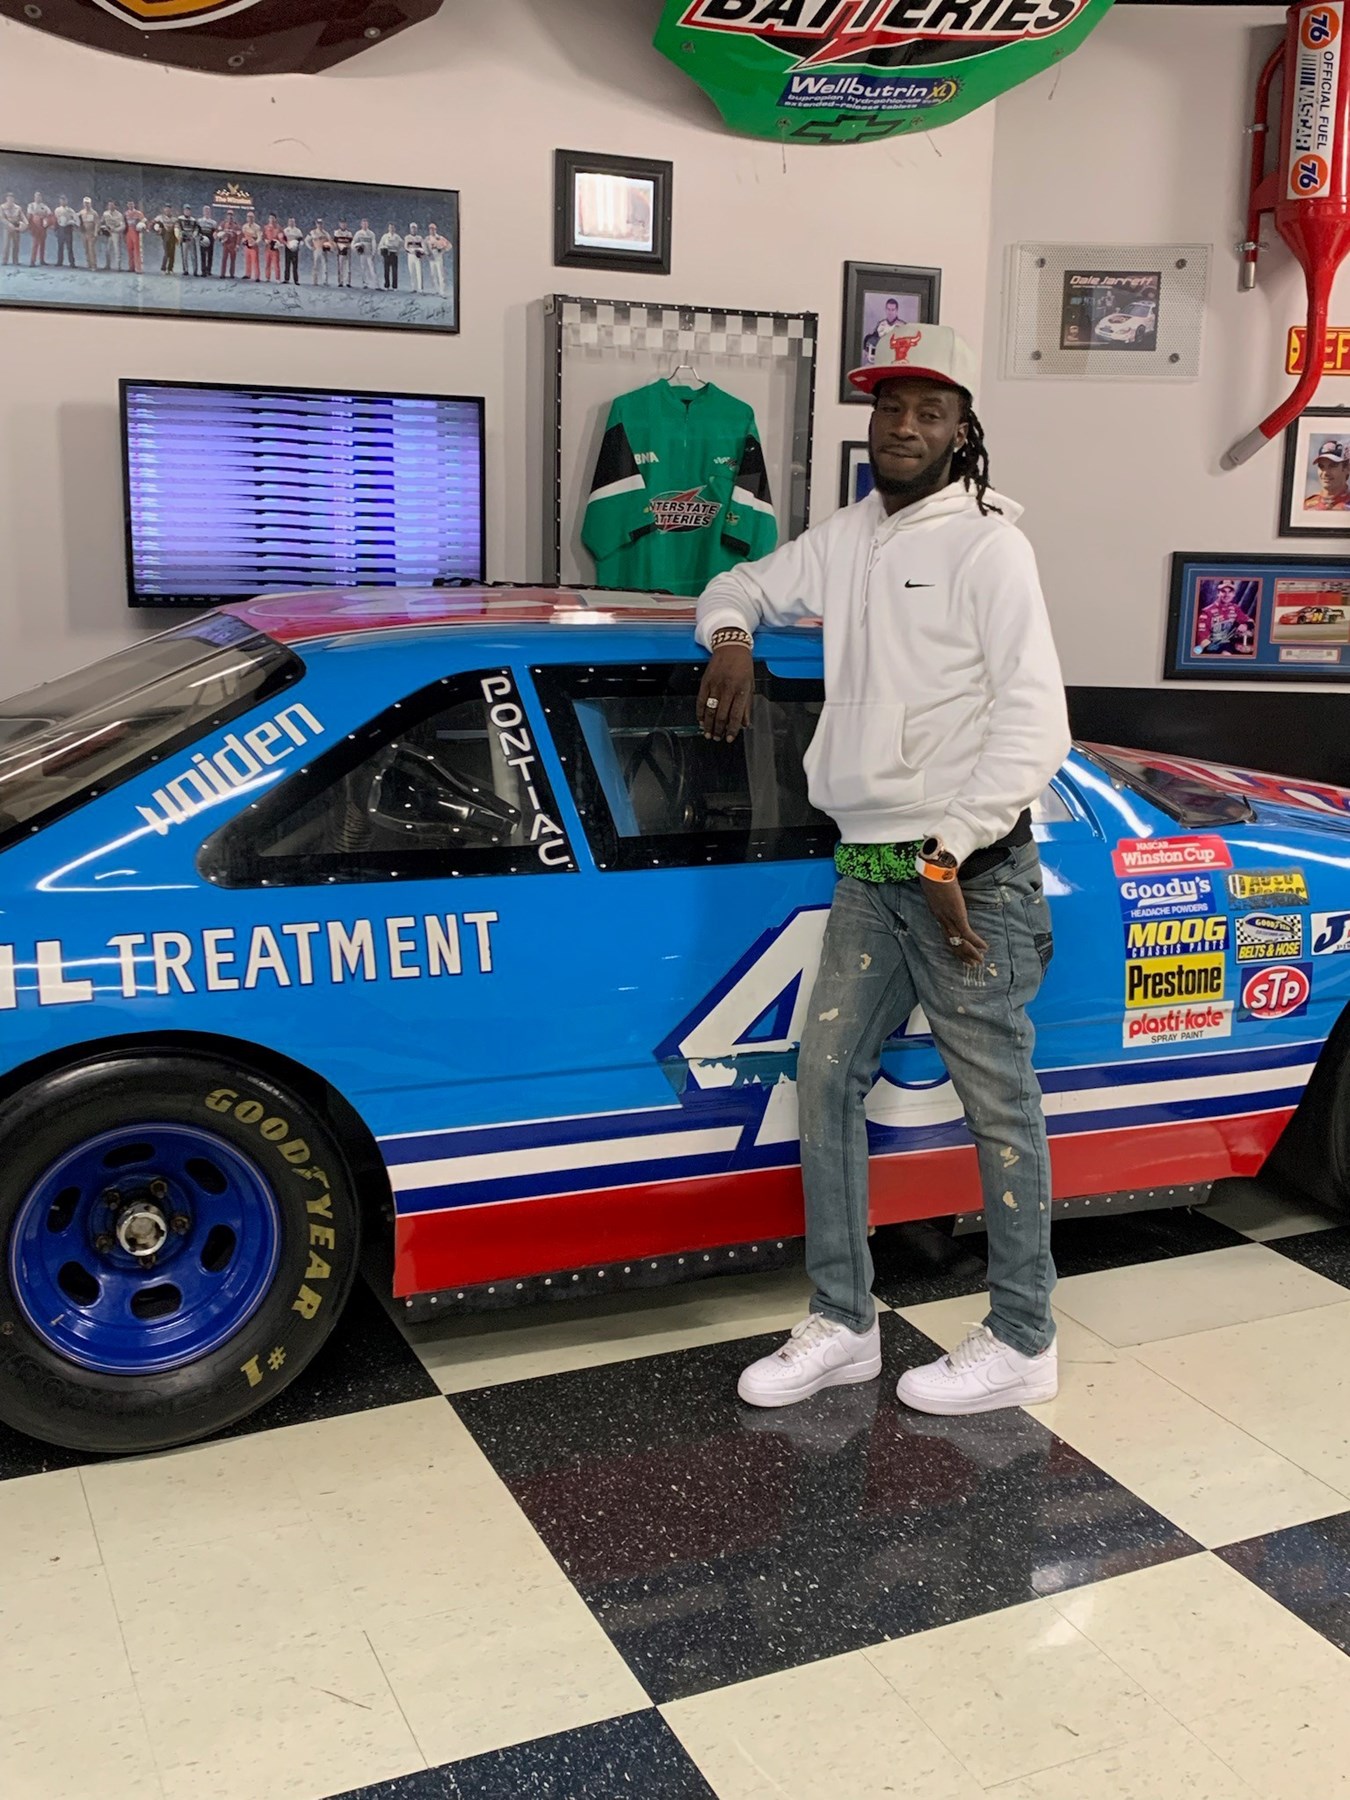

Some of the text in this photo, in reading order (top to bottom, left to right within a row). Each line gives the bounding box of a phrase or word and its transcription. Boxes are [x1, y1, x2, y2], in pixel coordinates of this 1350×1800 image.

[1308, 13, 1331, 44] 76
[792, 75, 928, 98] Wellbutrin
[1317, 50, 1334, 149] OFFICIAL FUEL
[1299, 160, 1319, 191] 76
[1070, 275, 1100, 285] Dale
[481, 676, 571, 866] PONTIAC
[1121, 847, 1216, 866] Winston Cup
[1136, 841, 1169, 851] NASCAR
[1121, 876, 1212, 901] Goody's
[1131, 903, 1209, 918] HEADACHE POWDERS
[1127, 916, 1227, 949] MOOG
[106, 911, 499, 998] TREATMENT
[1131, 940, 1225, 958] CHASSIS PARTS
[1239, 941, 1300, 959] BELTS & HOSE
[1128, 964, 1222, 1001] Prestone
[1250, 971, 1300, 1009] STP
[1129, 1006, 1224, 1038] plasti-kote
[1151, 1030, 1205, 1044] SPRAY PAINT
[204, 1088, 336, 1387] GOODYEAR #1
